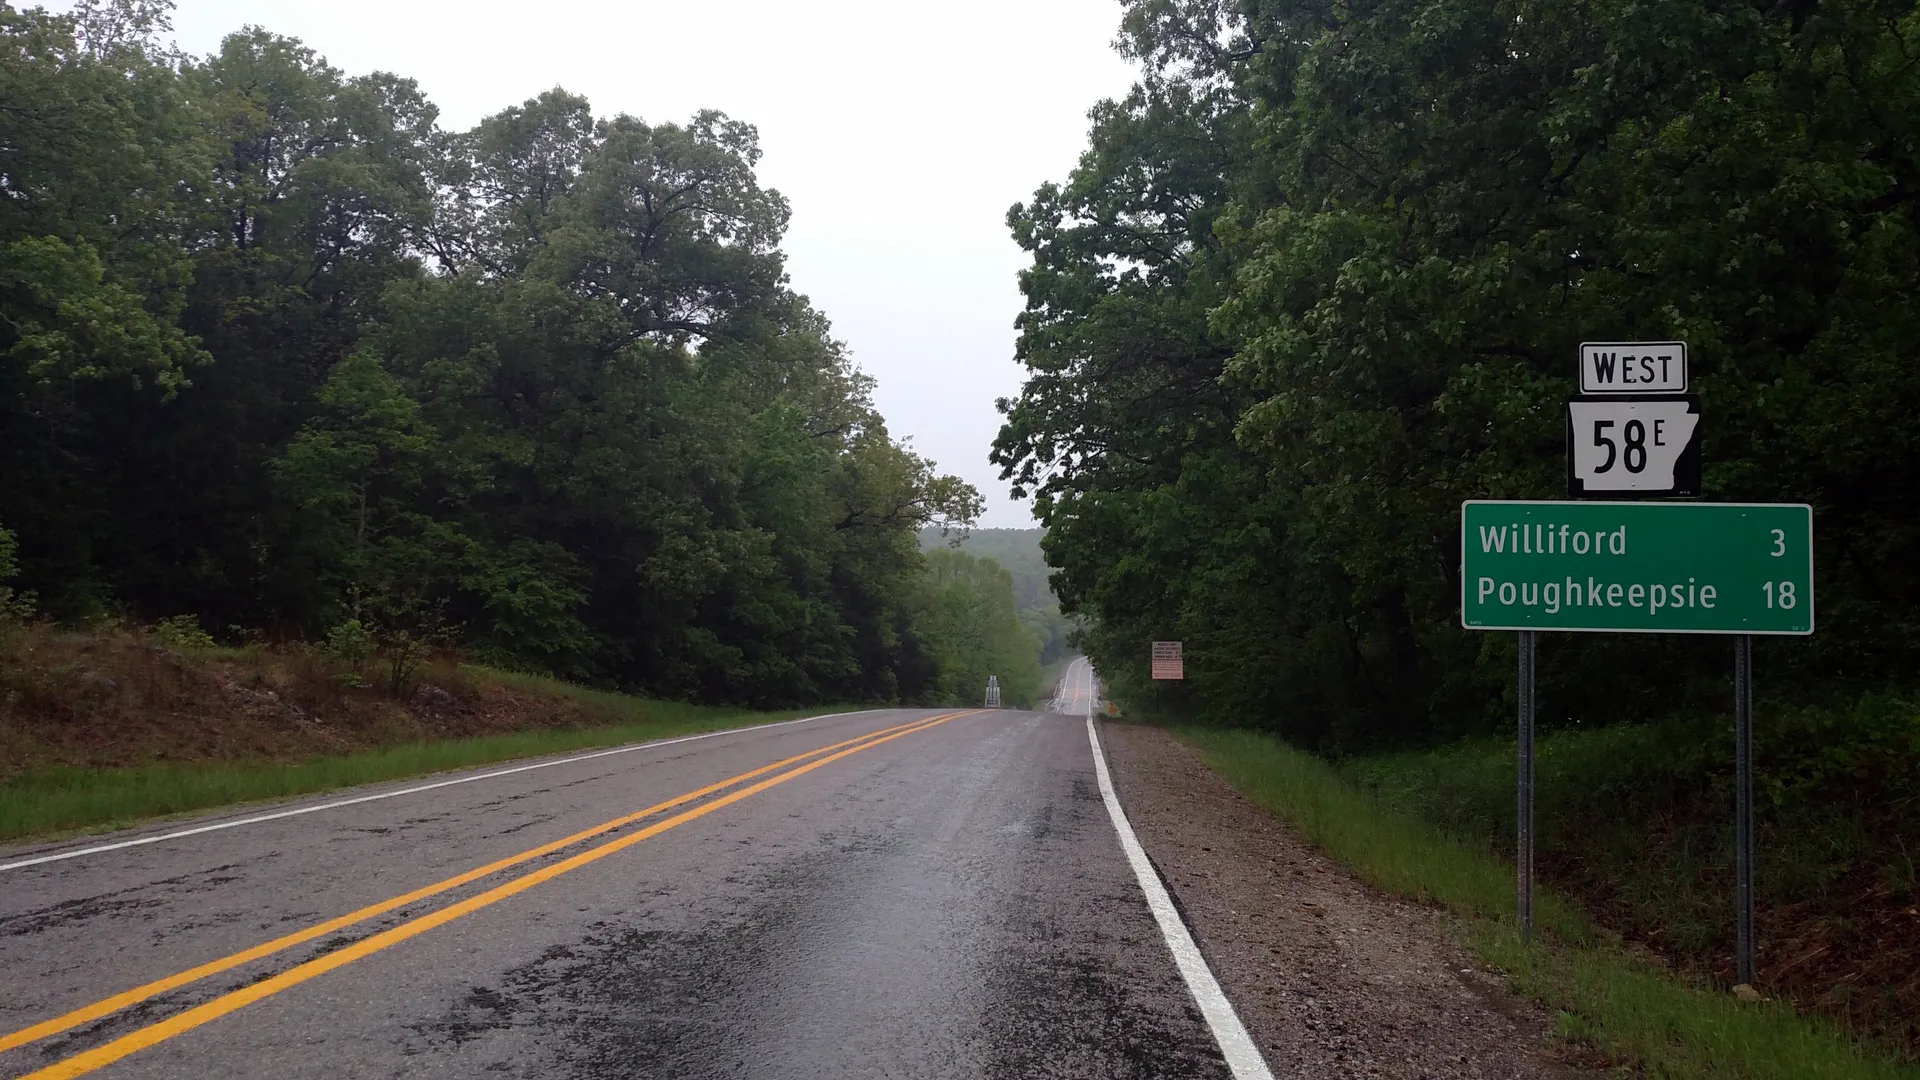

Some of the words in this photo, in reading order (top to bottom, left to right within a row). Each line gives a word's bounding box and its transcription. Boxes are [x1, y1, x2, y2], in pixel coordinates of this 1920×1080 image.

[1593, 353, 1673, 384] WEST
[1479, 524, 1626, 555] Williford
[1770, 529, 1786, 557] 3
[1478, 577, 1717, 615] Poughkeepsie
[1762, 581, 1797, 610] 18
